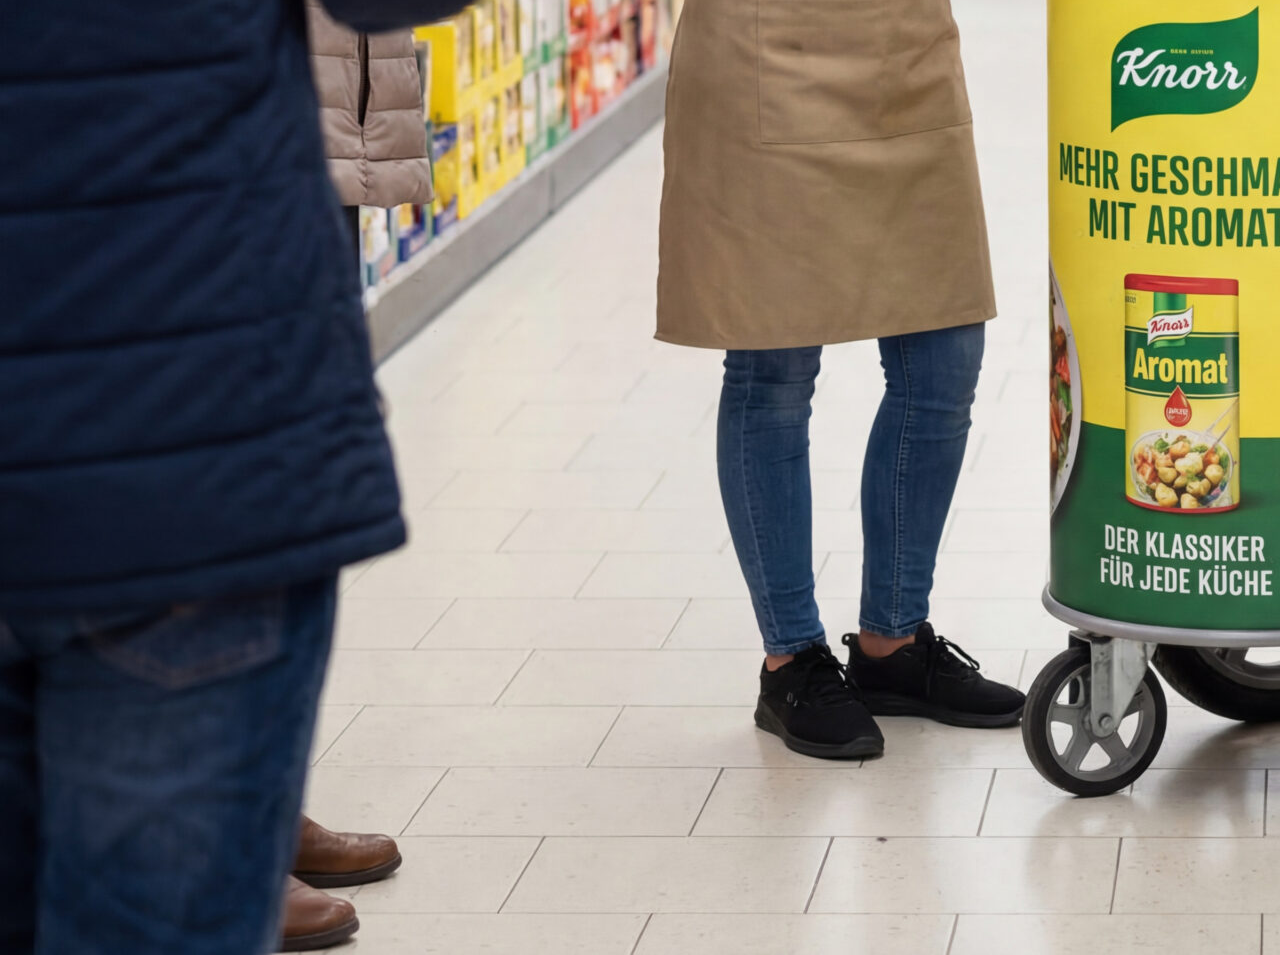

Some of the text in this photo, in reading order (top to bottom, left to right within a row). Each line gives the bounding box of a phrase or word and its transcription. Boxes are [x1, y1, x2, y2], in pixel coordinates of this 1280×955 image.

[1116, 47, 1247, 90] Knorr
[1059, 142, 1120, 191] MEHR
[1088, 198, 1137, 242] MIT
[1132, 347, 1229, 385] Aromat
[1104, 523, 1266, 563] DER KLASSIKER
[1100, 554, 1273, 597] FÜR JEDE KÜCHE
